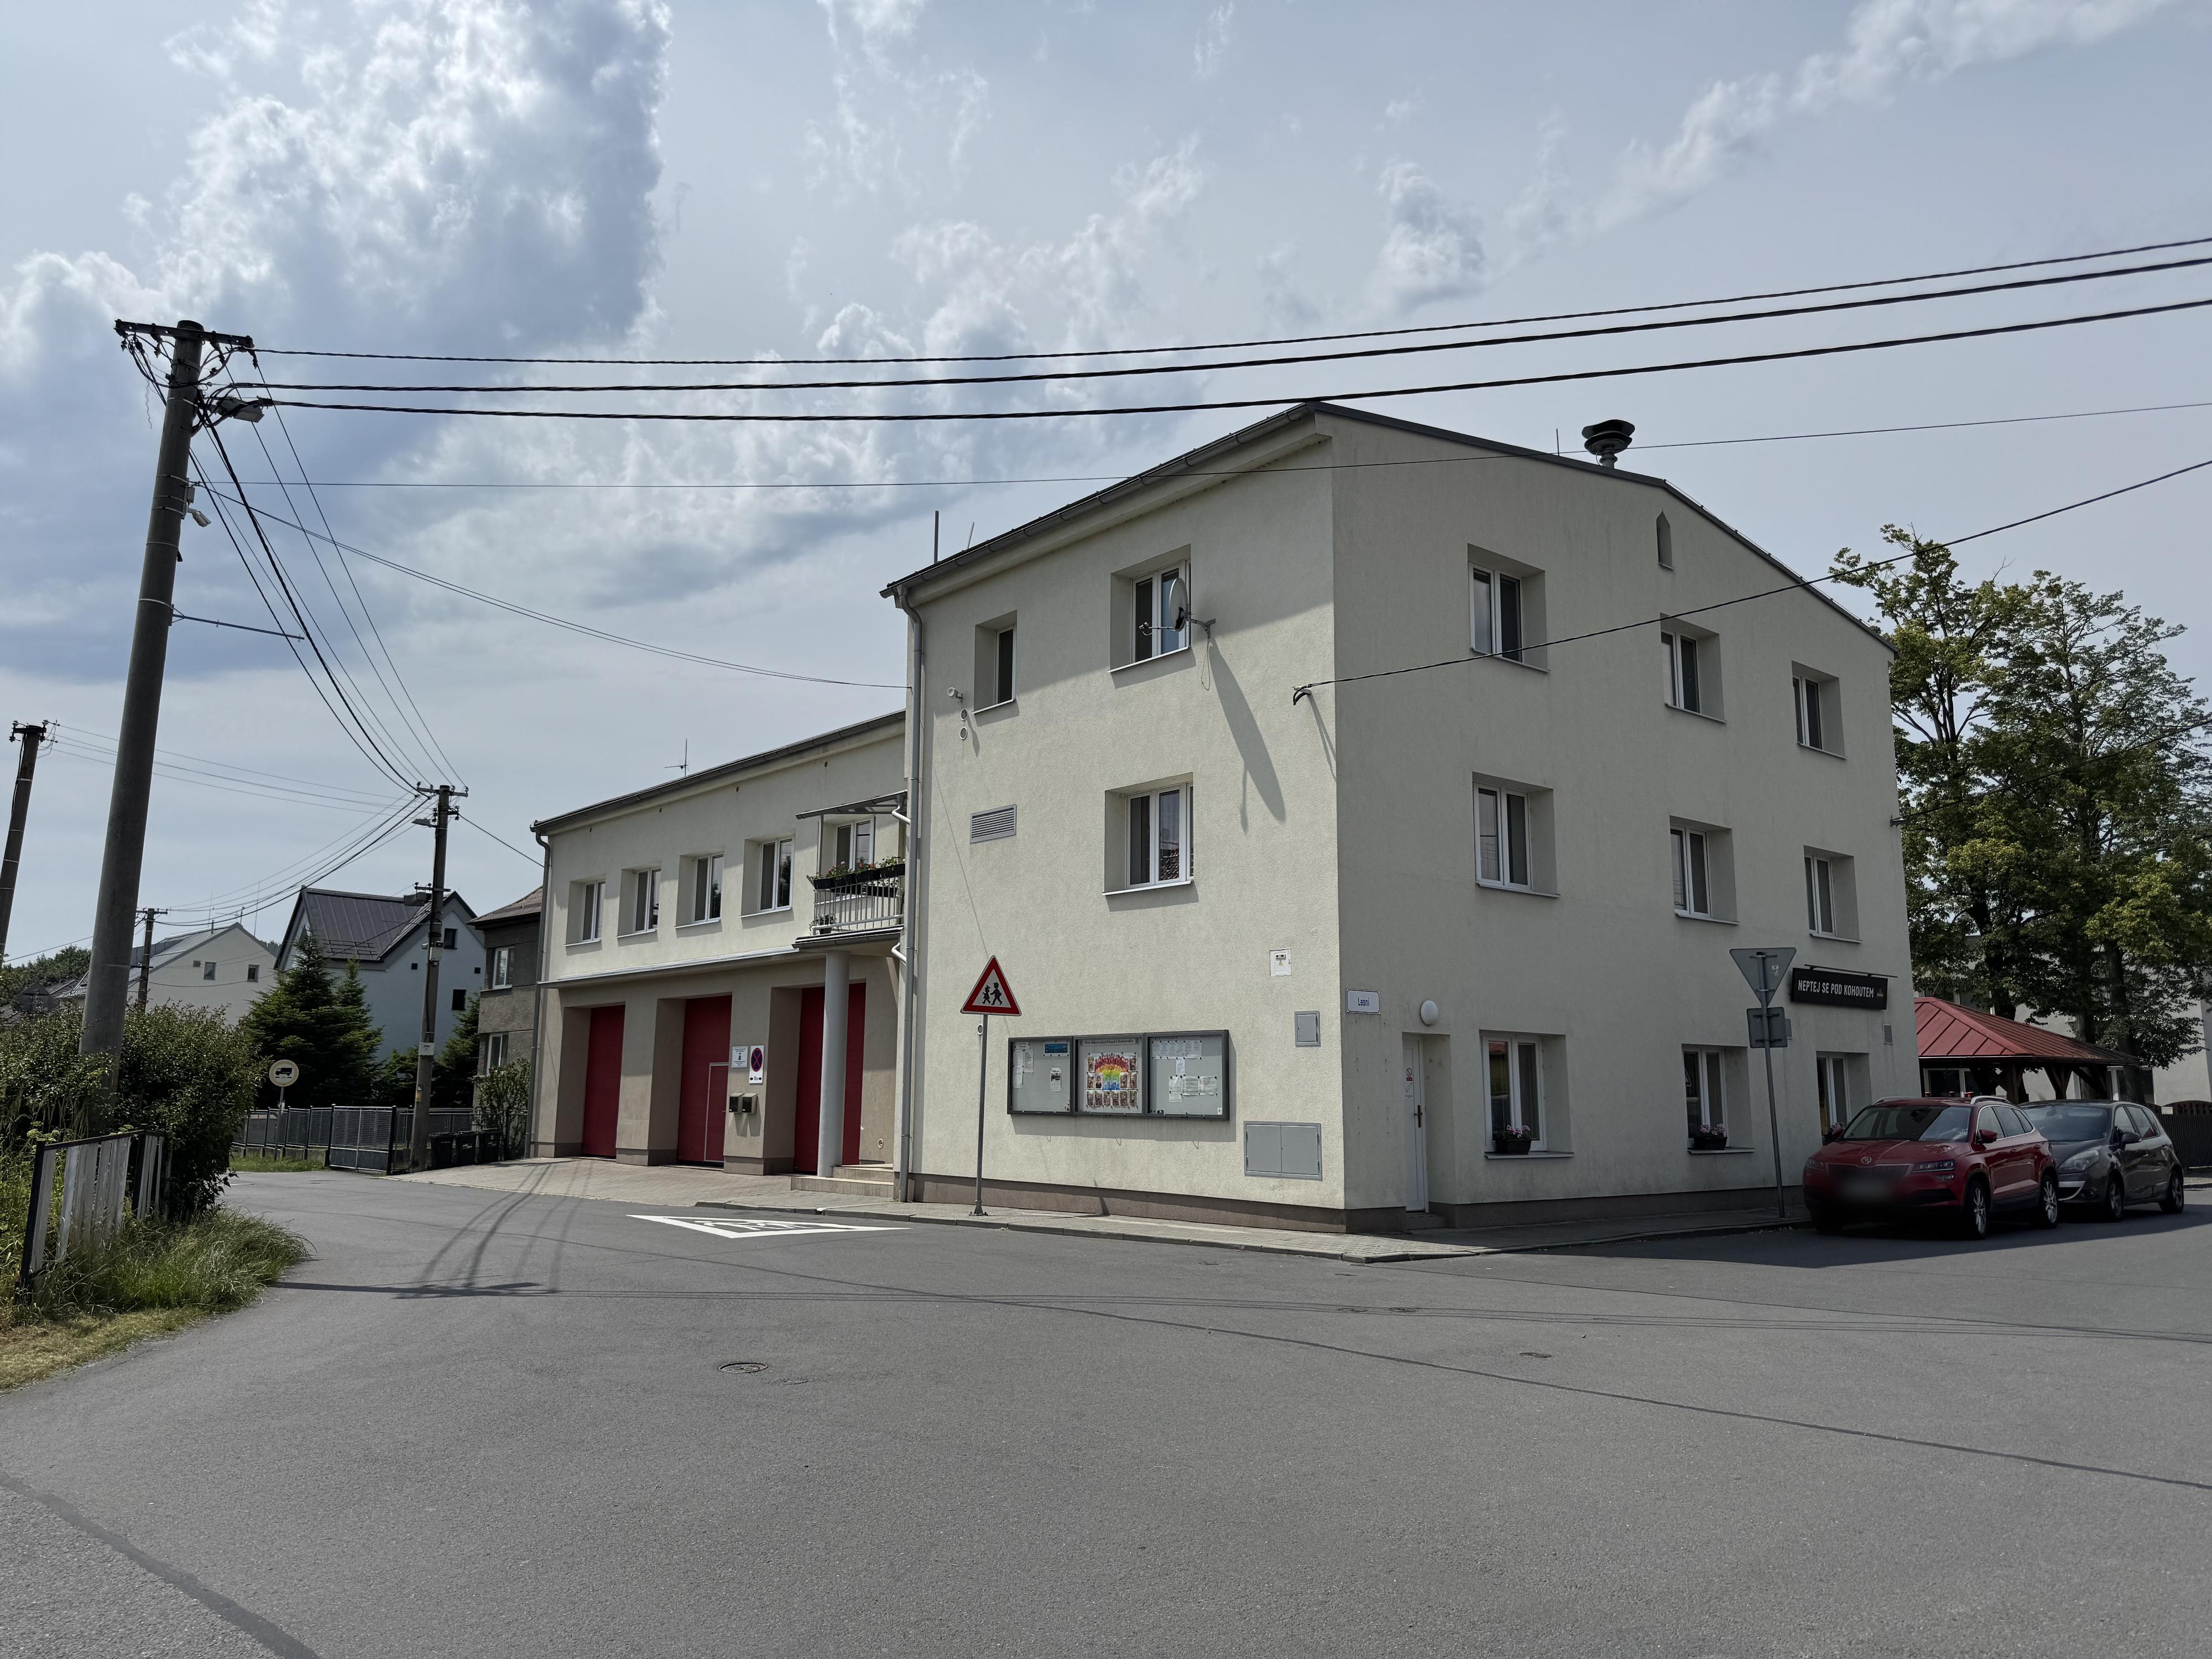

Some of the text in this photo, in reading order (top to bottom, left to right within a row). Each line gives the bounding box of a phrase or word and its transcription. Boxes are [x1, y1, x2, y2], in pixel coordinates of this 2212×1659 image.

[1798, 979, 1874, 998] NEPTEJ SE POD KOHOUTEM
